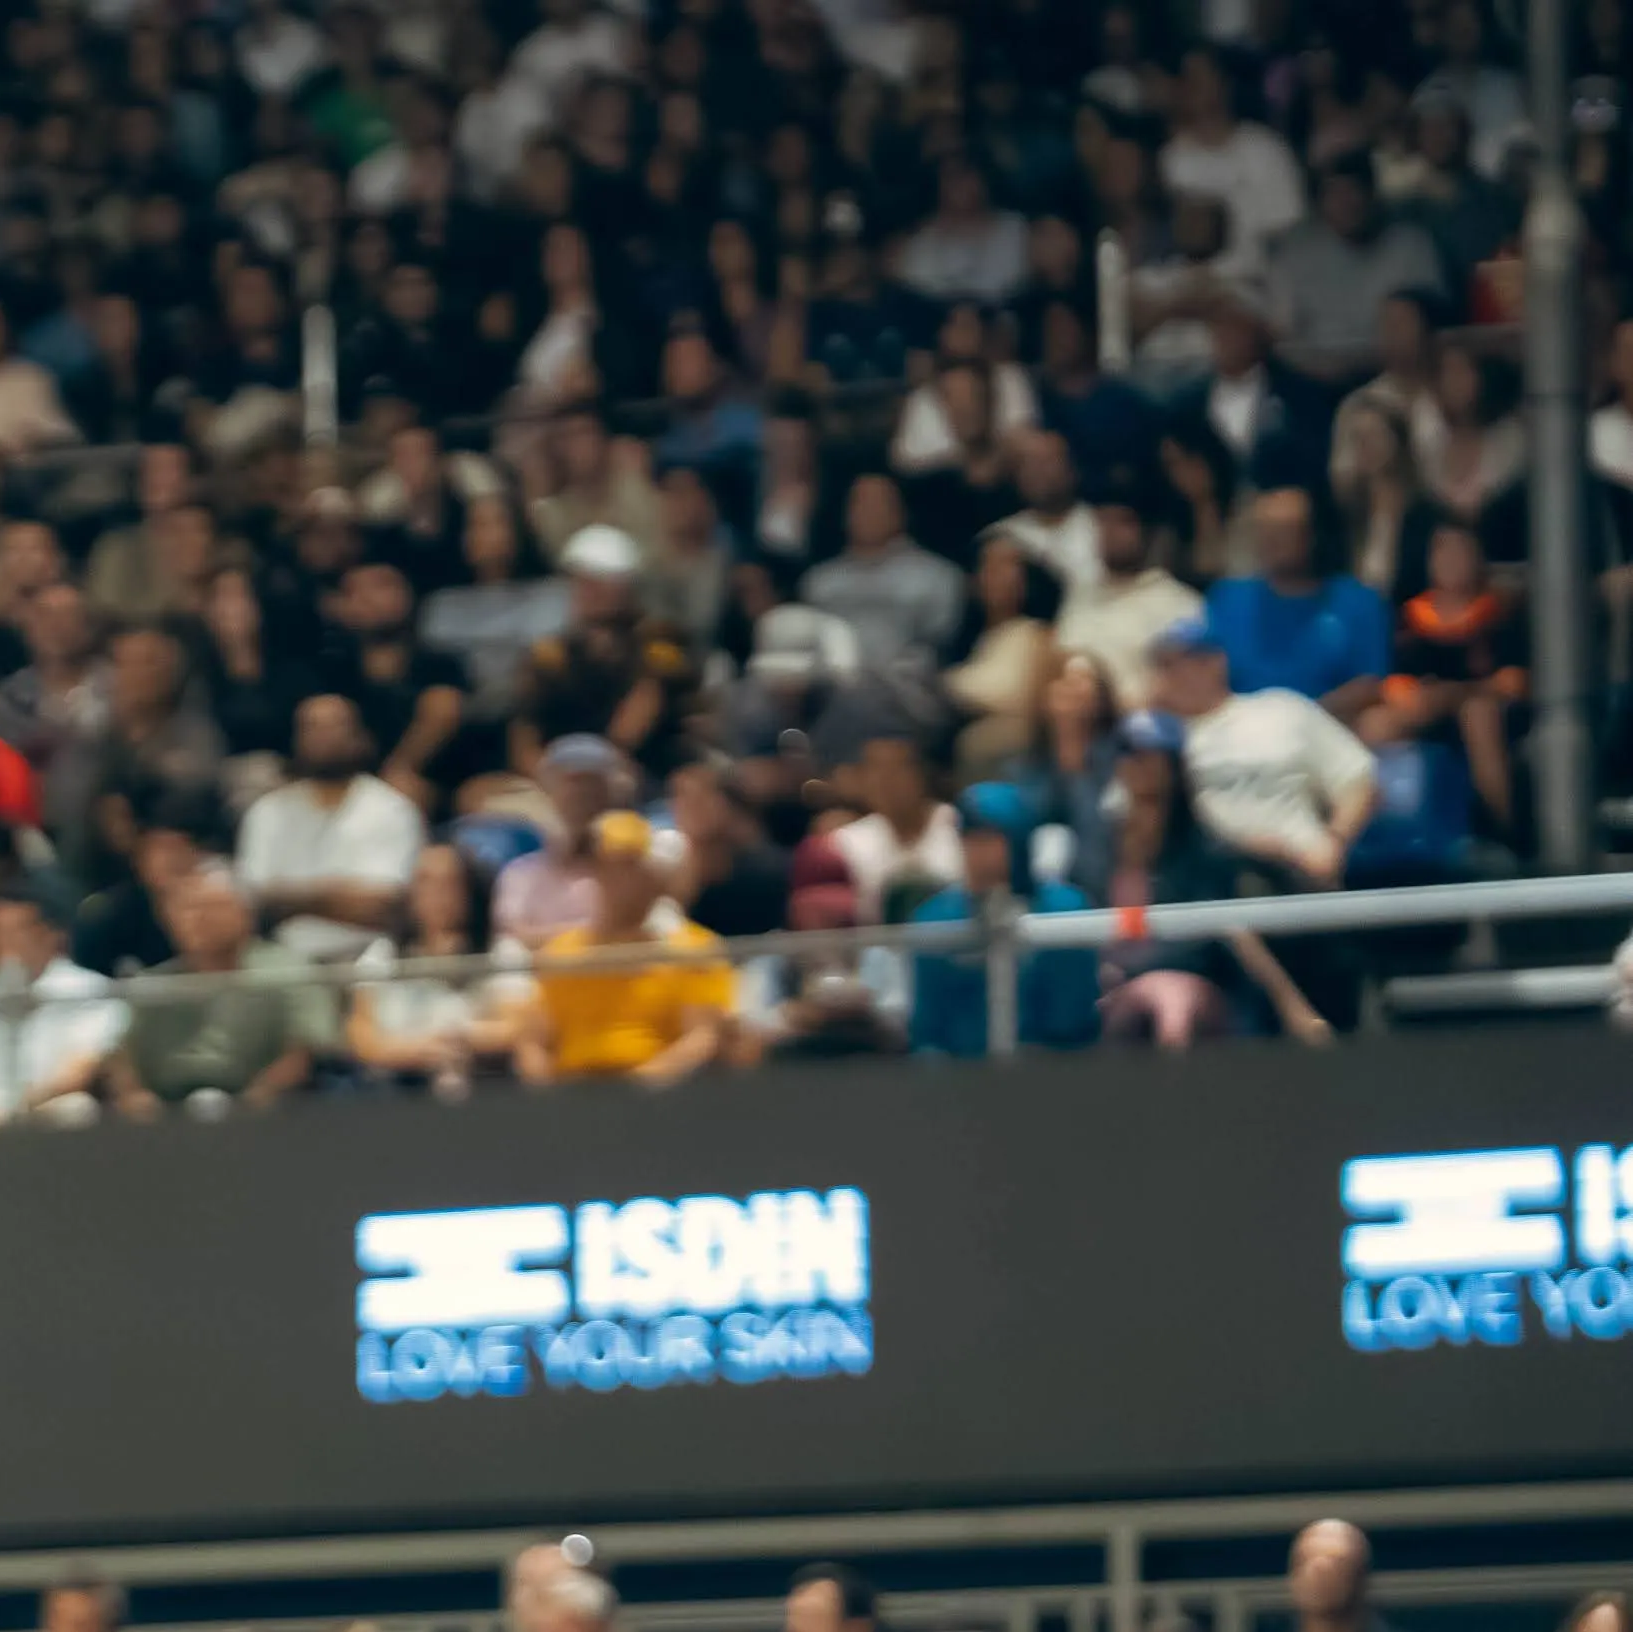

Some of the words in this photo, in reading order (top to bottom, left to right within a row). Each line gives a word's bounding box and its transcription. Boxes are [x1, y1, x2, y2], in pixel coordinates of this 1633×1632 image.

[575, 1185, 872, 1322] ISDIN
[1341, 1274, 1523, 1353] LOVE
[355, 1324, 529, 1403] LOVE
[531, 1314, 718, 1391] YOUR
